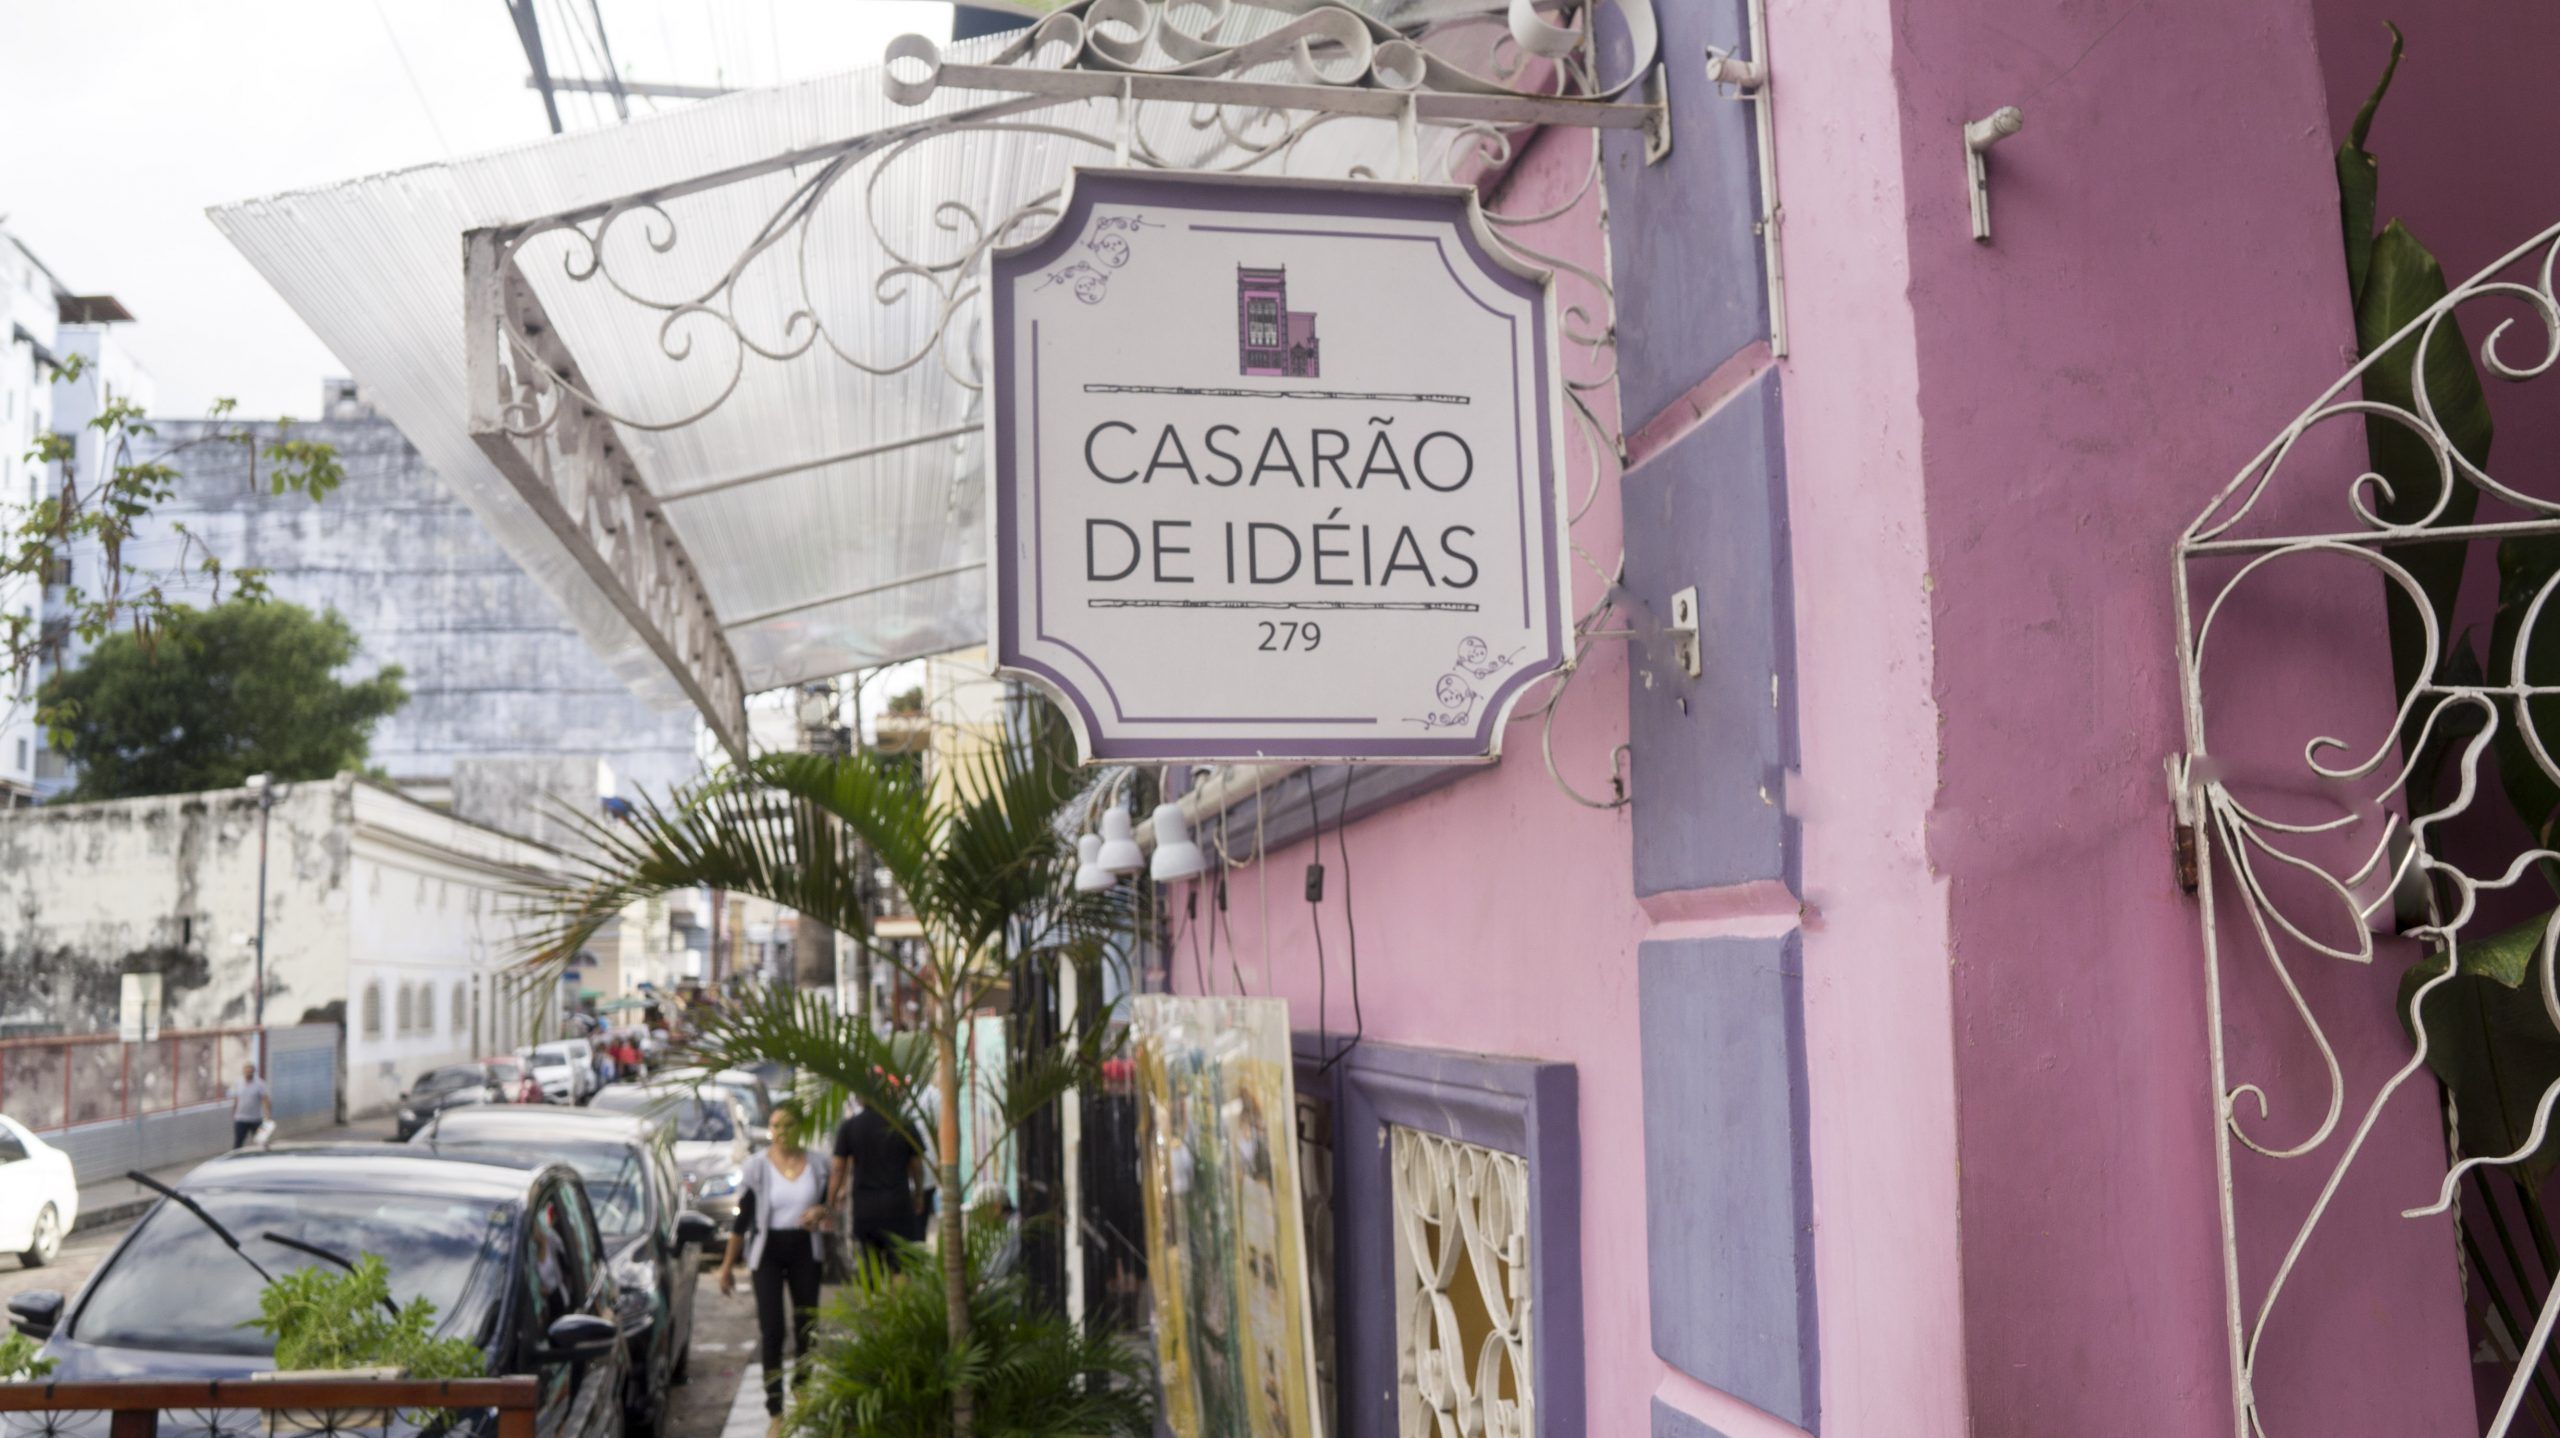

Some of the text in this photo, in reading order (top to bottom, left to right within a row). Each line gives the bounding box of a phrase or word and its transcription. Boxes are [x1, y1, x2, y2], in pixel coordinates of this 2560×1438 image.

[1084, 416, 1474, 493] CASARÃO
[1085, 507, 1479, 588] DE IDÉIAS
[1257, 621, 1322, 652] 279
